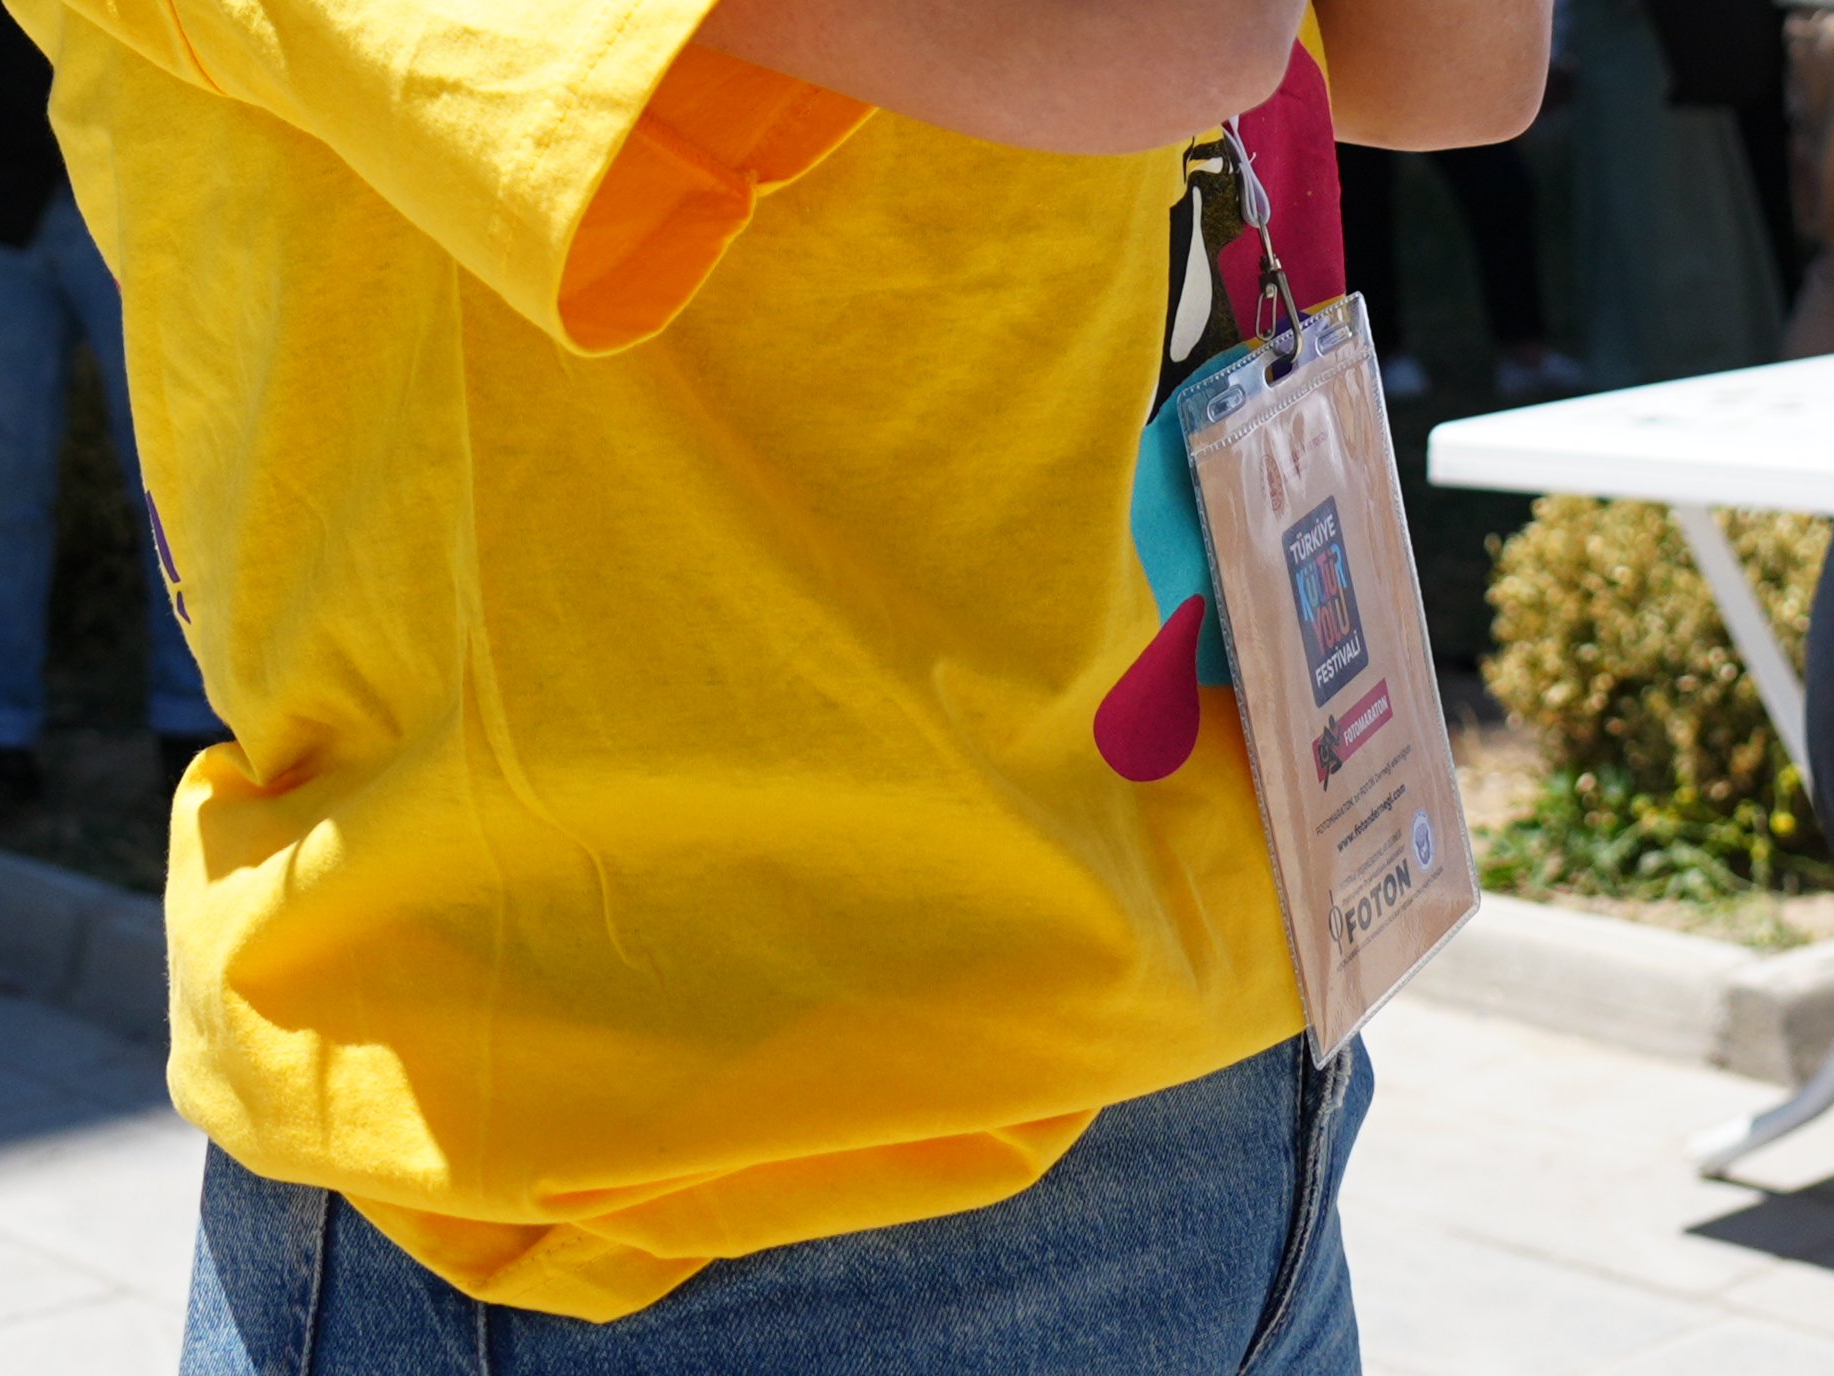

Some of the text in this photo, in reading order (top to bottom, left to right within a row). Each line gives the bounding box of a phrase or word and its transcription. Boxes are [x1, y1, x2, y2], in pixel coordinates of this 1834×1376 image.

[1290, 514, 1336, 564] TÜRKİYE
[1315, 630, 1361, 688] FESTİVALİ
[1343, 694, 1389, 747] FOTOMARATON
[1345, 858, 1411, 944] FOTON
